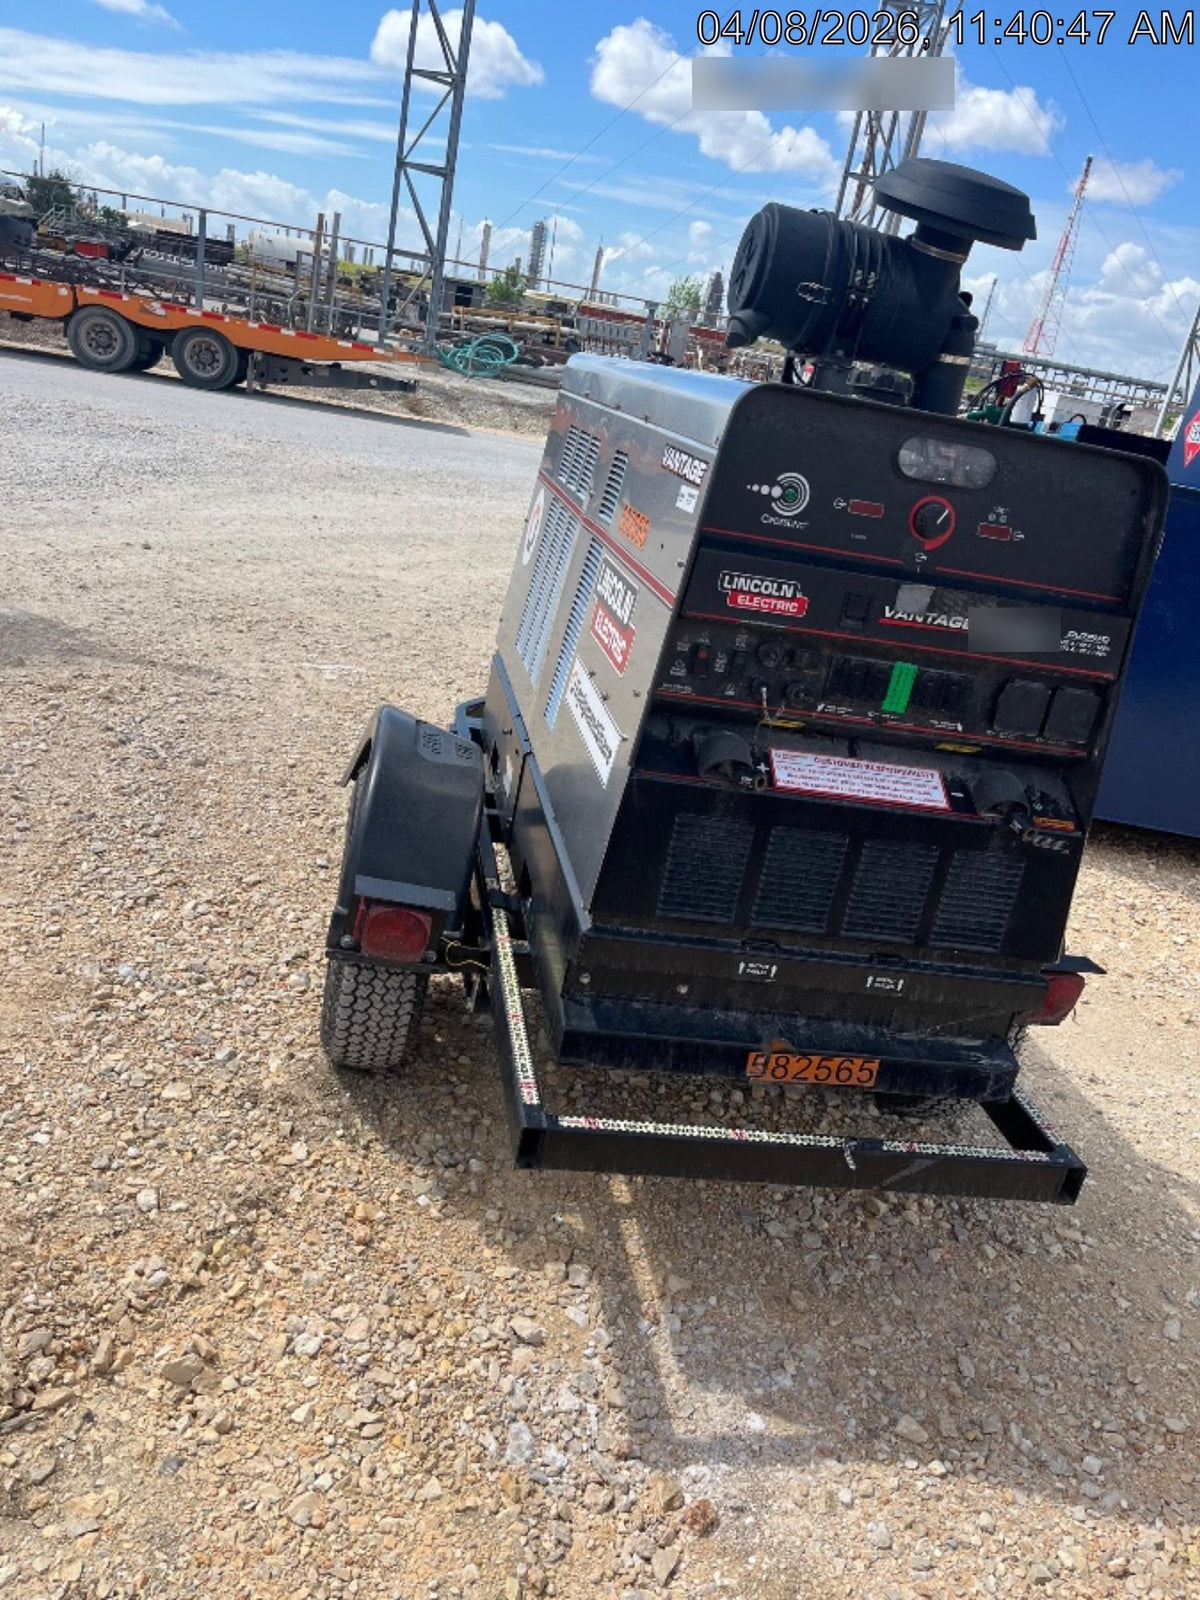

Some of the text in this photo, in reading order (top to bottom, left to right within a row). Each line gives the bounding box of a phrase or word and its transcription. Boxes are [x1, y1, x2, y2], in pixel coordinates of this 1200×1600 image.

[662, 447, 708, 485] VANTAGE
[597, 563, 636, 626] LINCOLN
[723, 575, 794, 598] LINCOLN
[737, 594, 799, 613] ELECTRIC
[594, 608, 627, 664] ELECTRIC
